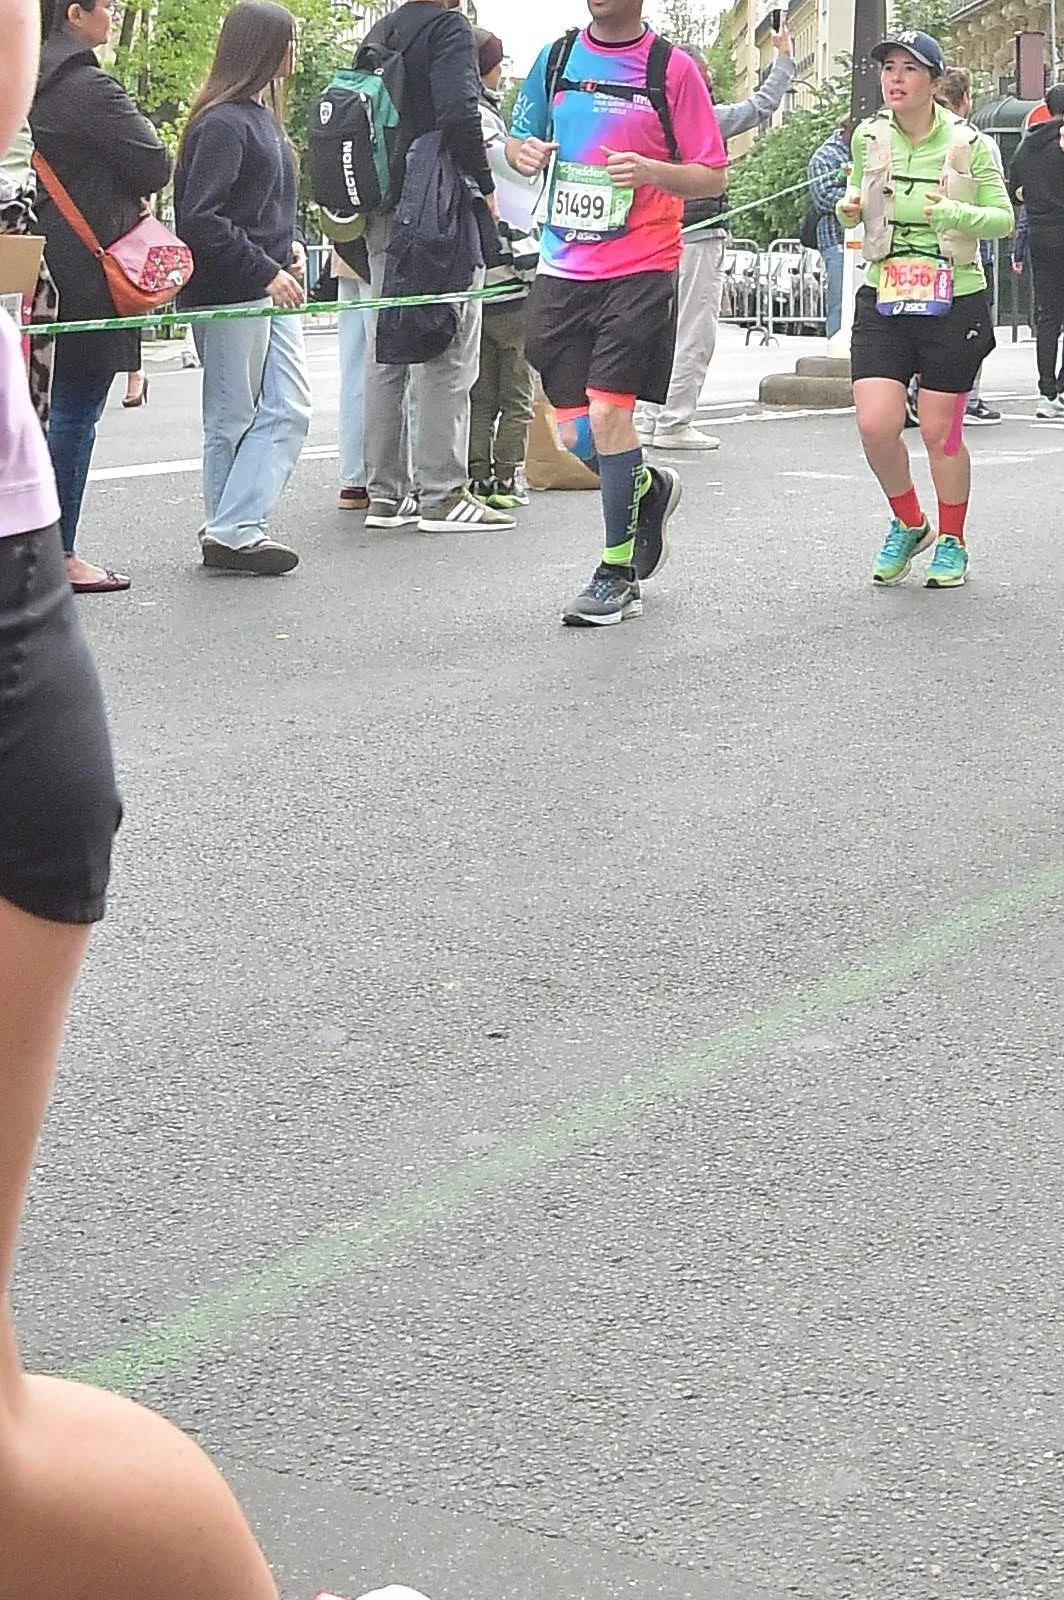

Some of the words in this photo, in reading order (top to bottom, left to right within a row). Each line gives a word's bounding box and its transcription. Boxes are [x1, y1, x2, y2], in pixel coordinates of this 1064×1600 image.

[342, 140, 361, 206] SECTION
[556, 190, 605, 220] 51499
[883, 263, 931, 289] 79656
